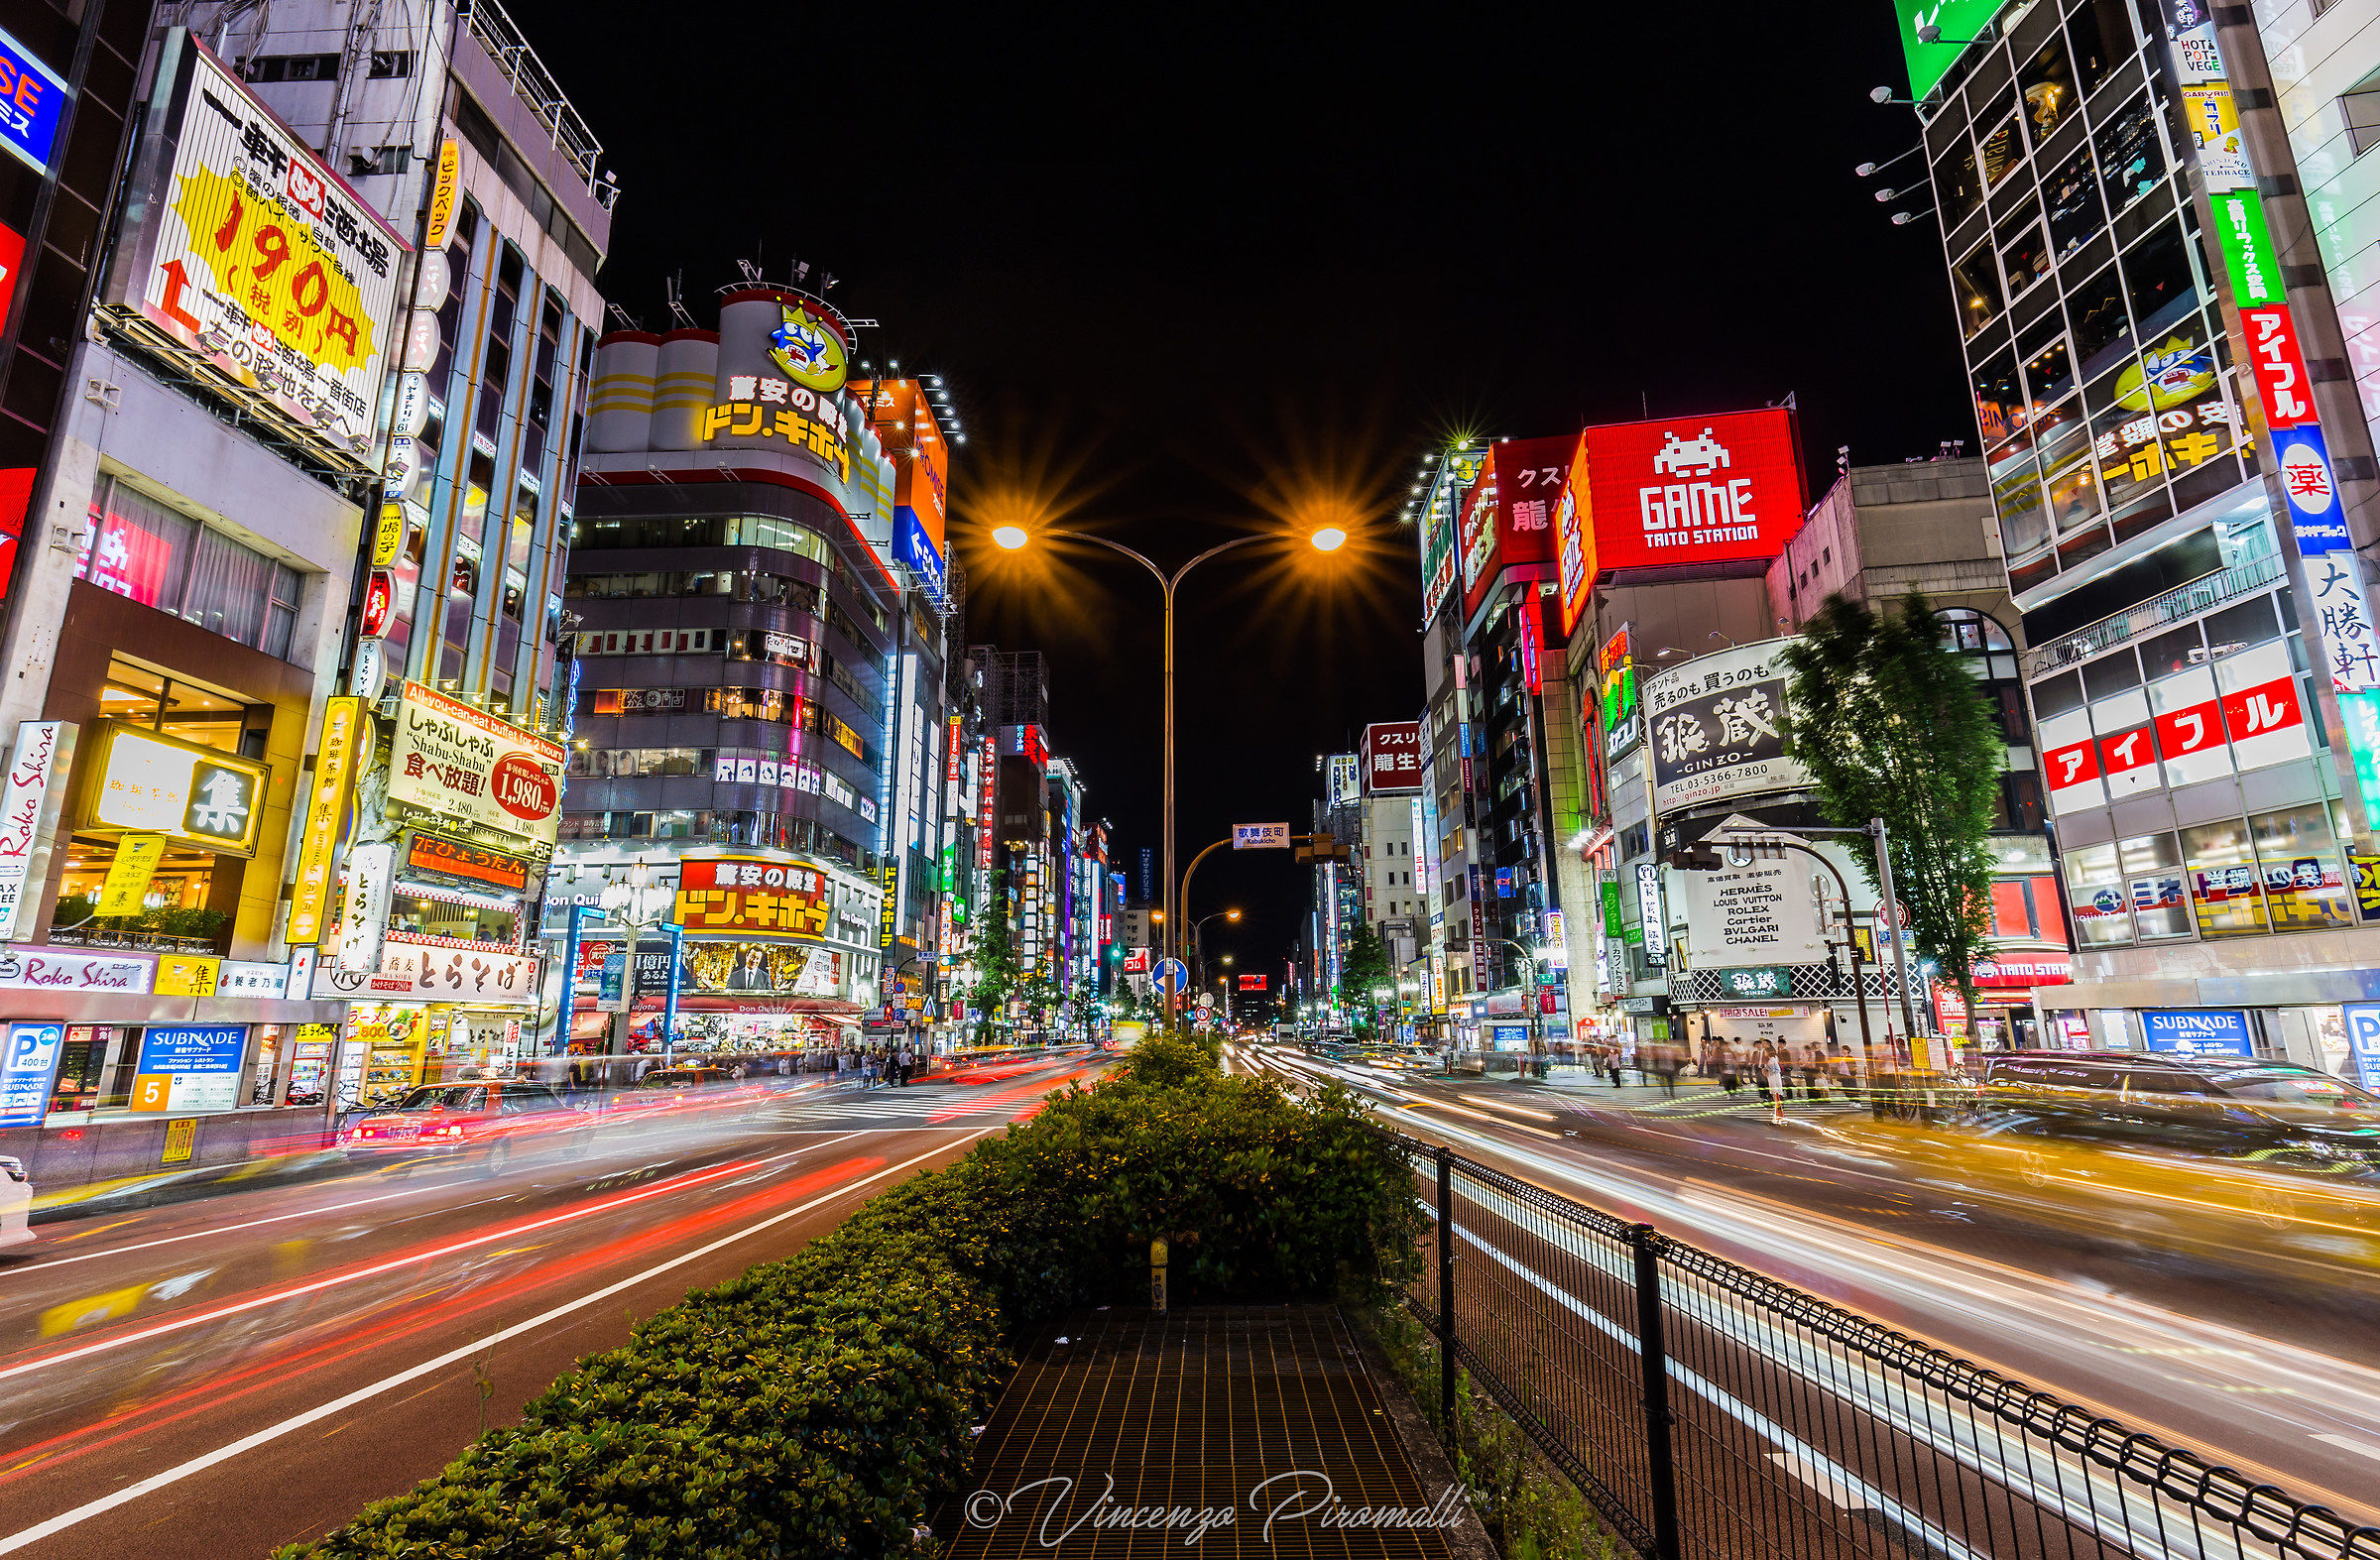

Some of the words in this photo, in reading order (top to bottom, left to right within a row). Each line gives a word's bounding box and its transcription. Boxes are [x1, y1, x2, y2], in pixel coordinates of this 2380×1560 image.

[2182, 40, 2208, 50] HOT
[2185, 51, 2209, 61] POT
[2187, 60, 2220, 71] VEGE
[2203, 169, 2250, 178] TERRACE
[2251, 313, 2306, 418] アイフル
[2286, 462, 2330, 496] 薬
[1639, 477, 1756, 531] GAME
[1644, 533, 1689, 548] TAITO
[1693, 524, 1759, 544] STATION
[2318, 562, 2379, 682] 大勝軒
[409, 686, 489, 728] All-you-can-eat
[491, 719, 517, 740] buffet
[519, 733, 532, 746] for
[534, 739, 539, 751] 2
[540, 743, 563, 761] hours
[409, 708, 495, 758] しゃぶしゃぶ
[1379, 733, 1422, 745] クスリ
[2059, 692, 2285, 782] アイフル
[12, 725, 54, 787] Shira
[985, 743, 995, 784] カラオケ
[1374, 753, 1422, 772] 龍生
[404, 752, 487, 797] 食べ放題!
[192, 769, 249, 833] 集
[499, 774, 541, 810] 1,980
[539, 804, 550, 813] yen
[1662, 784, 1721, 807] http://ginzo.jp
[314, 803, 333, 822] 集
[0, 797, 37, 858] Roko
[473, 827, 508, 844] USAGIYA
[1238, 827, 1284, 838] 歌舞伎町
[415, 836, 525, 875] 7Fひょうたん
[536, 842, 552, 859] 5F
[715, 864, 816, 893] 驚安の殿堂
[1707, 874, 1740, 883] 高価買取
[1720, 882, 1773, 897] HERMÈS
[1713, 898, 1738, 907] LOUIS
[1742, 894, 1782, 904] VUITTON
[1727, 904, 1770, 915] ROLEX
[345, 873, 370, 950] とらそば
[1726, 915, 1772, 925] Cartier
[1724, 924, 1779, 935] BVLGARI
[1726, 935, 1779, 945] CHANEL
[24, 958, 72, 986] Roko
[79, 962, 128, 988] Shira
[189, 965, 212, 994] 集
[418, 951, 522, 993] とらそば
[642, 970, 667, 979] あるよ
[1999, 964, 2034, 976] TAITO
[234, 976, 285, 990] 養老乃瀧
[758, 1005, 786, 1014] Quijote
[361, 1026, 385, 1037] 500
[2153, 1016, 2238, 1030] SUBNADE
[153, 1032, 238, 1046] SUBNADE
[11, 1035, 37, 1067] P
[145, 1082, 160, 1103] 5
